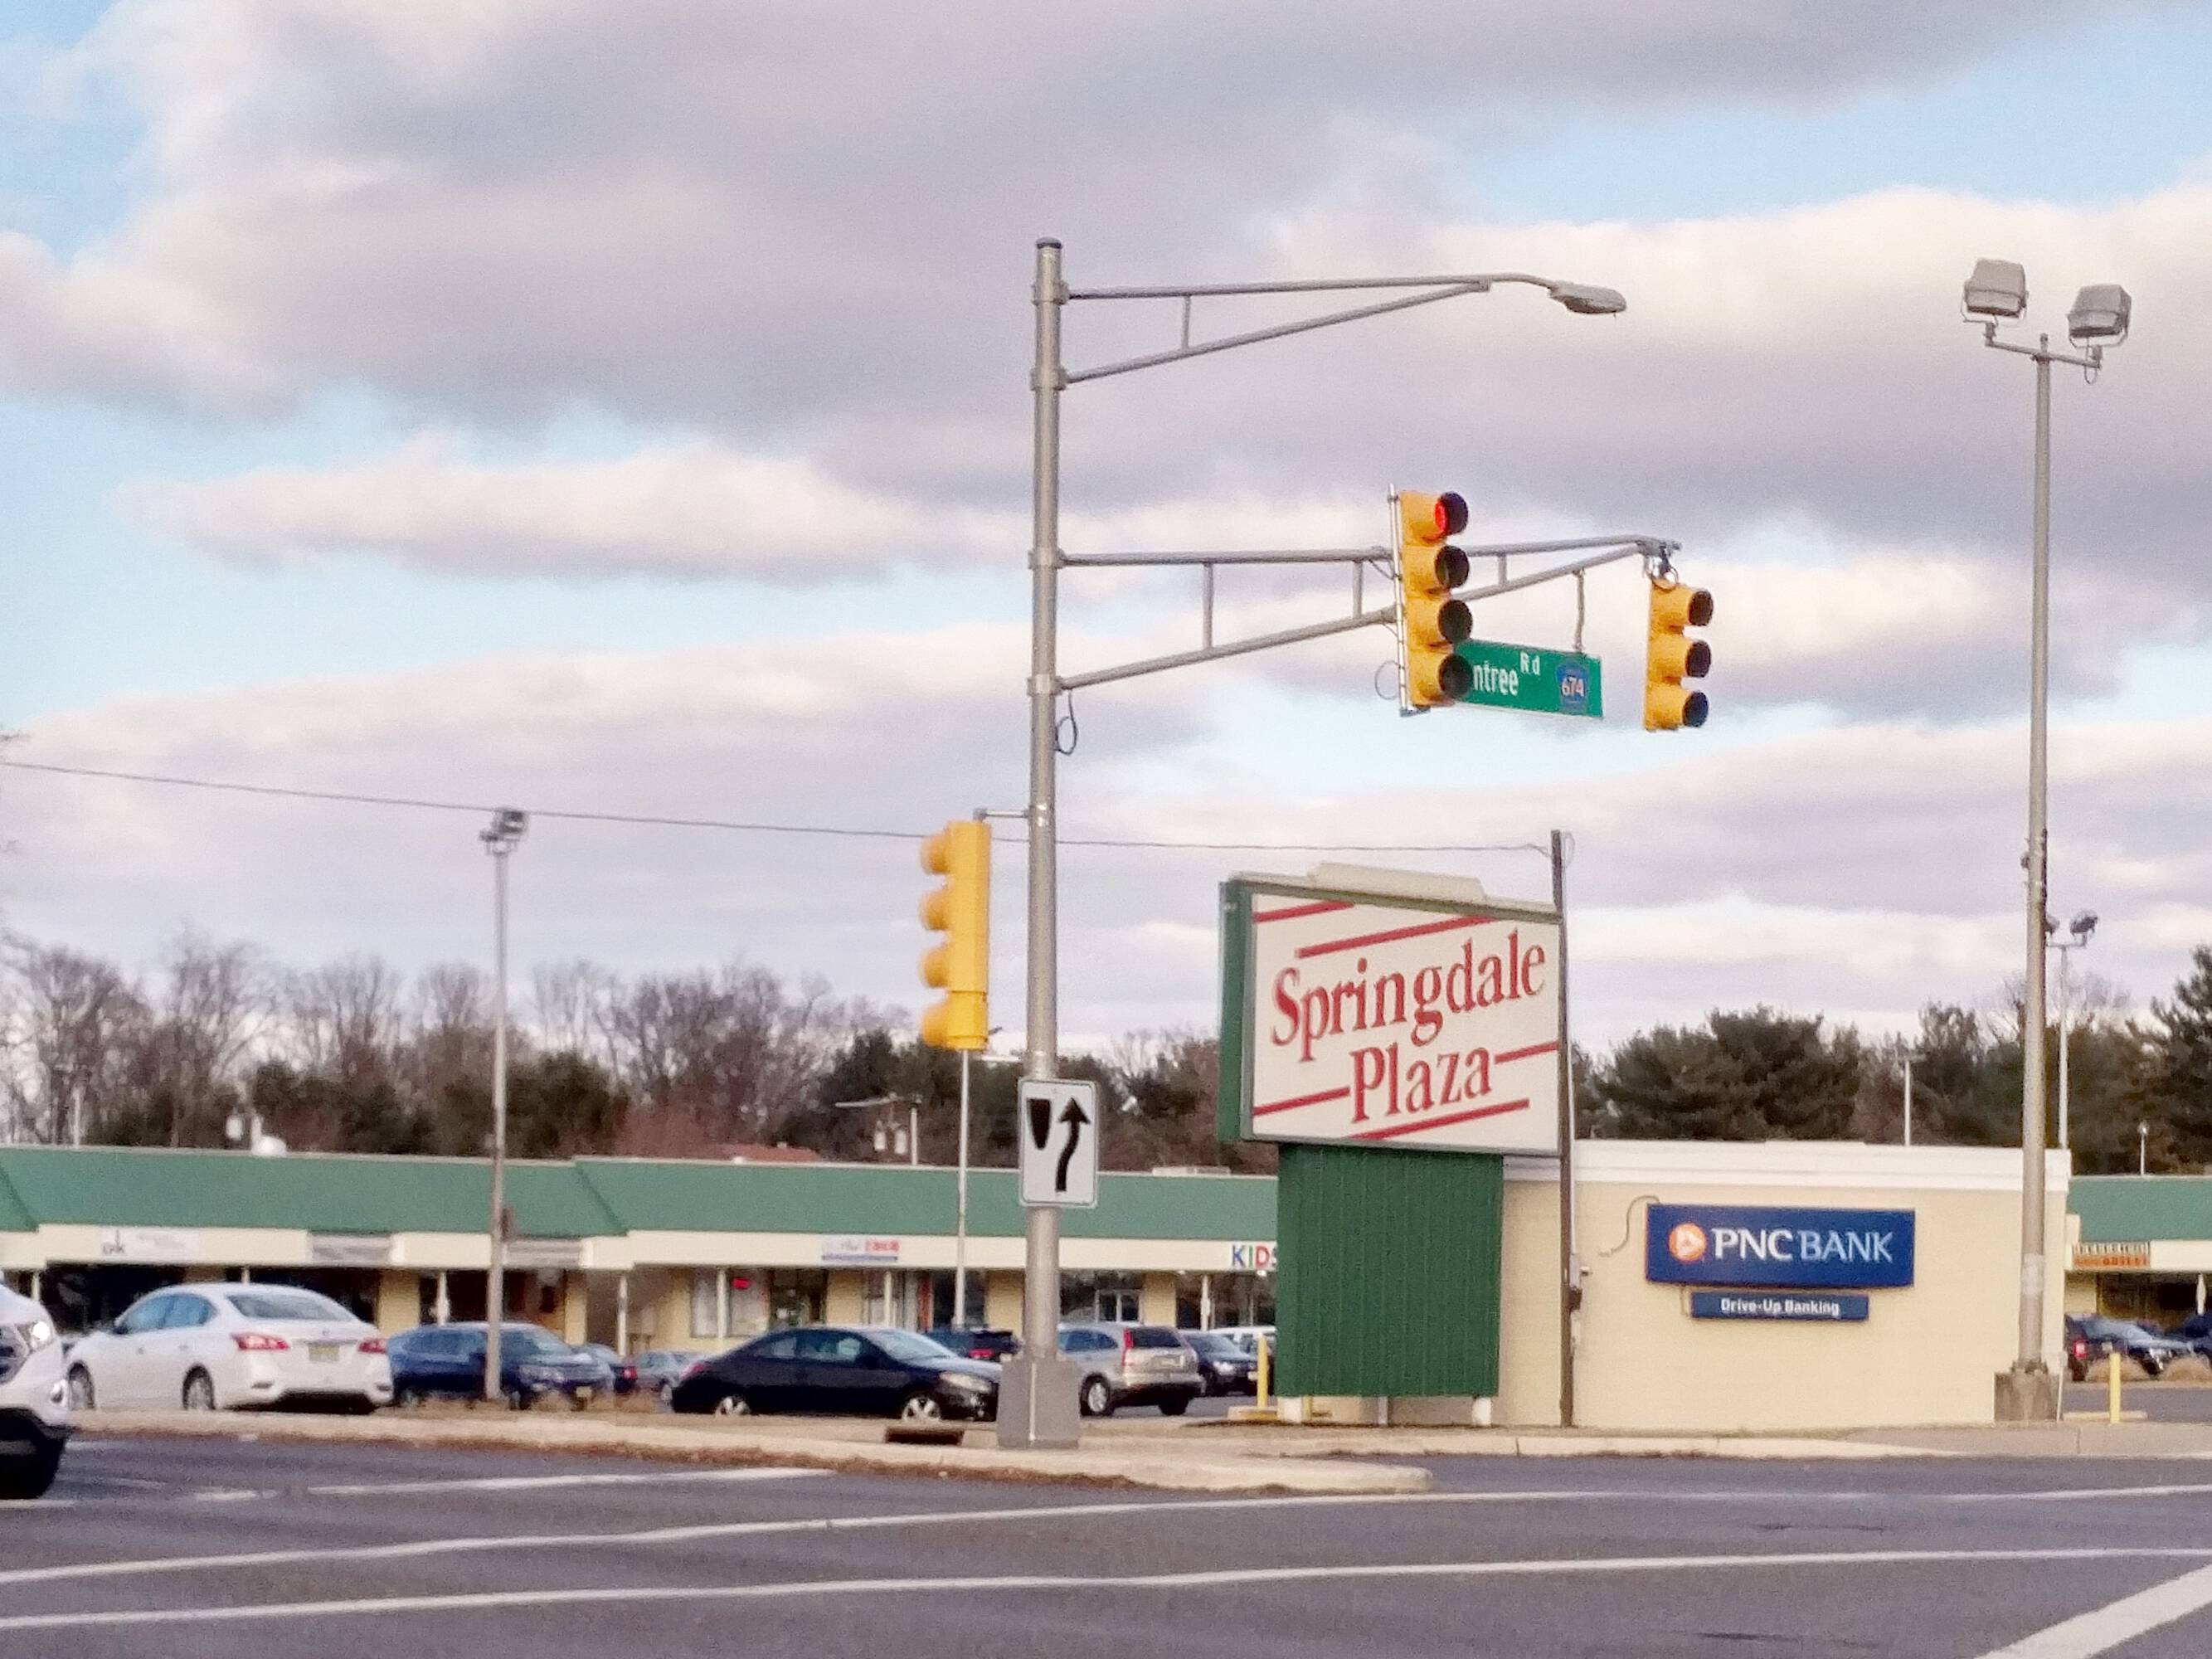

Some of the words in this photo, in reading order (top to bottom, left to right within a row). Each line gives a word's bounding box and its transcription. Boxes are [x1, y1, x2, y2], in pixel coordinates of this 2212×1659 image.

[1472, 660, 1519, 697] ntree
[1519, 651, 1541, 676] Rd
[1561, 675, 1585, 698] 674
[1270, 927, 1546, 1063] Springdale
[1349, 1042, 1492, 1124] Plaza
[1711, 1227, 1794, 1262] PNC
[1796, 1229, 1894, 1263] BANK
[1720, 1297, 1782, 1314] Drive-Up
[1784, 1298, 1840, 1316] Banking
